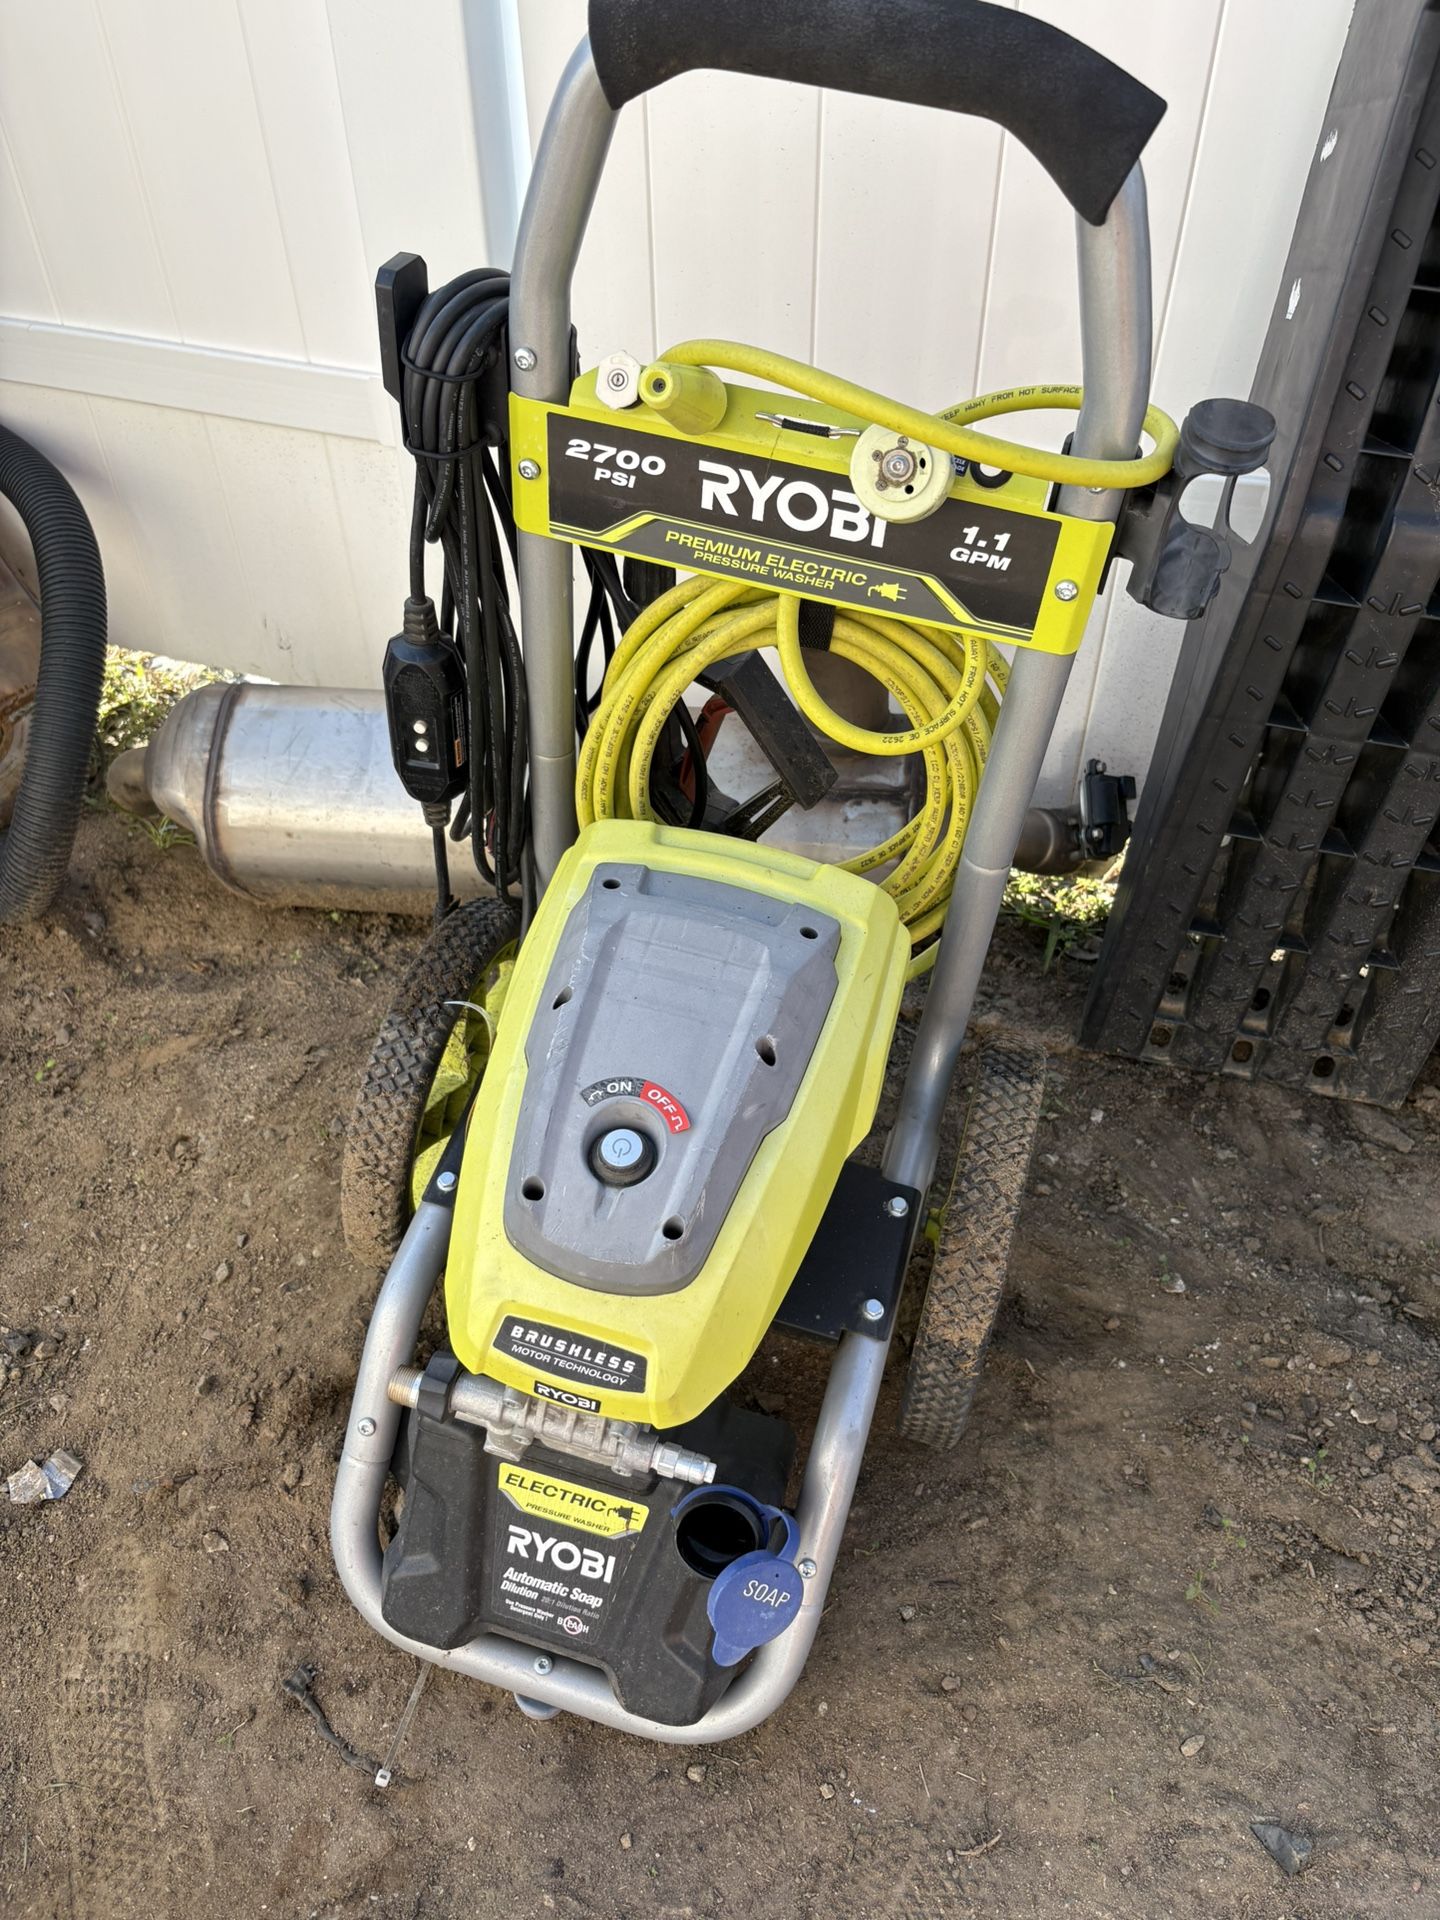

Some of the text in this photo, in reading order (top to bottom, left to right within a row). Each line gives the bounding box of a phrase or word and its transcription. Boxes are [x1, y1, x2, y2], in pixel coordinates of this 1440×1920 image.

[1018, 388, 1036, 397] HOT
[565, 438, 666, 476] 2700
[594, 467, 636, 489] PSI
[698, 459, 888, 548] RYOBI
[962, 526, 1011, 551] 1.1
[665, 530, 867, 586] PREMIUM ELECTRIC
[693, 551, 835, 590] PRESSURE WASHER
[949, 547, 1012, 571] GPM
[967, 666, 978, 688] FROM
[957, 690, 969, 707] HOT
[924, 709, 956, 735] SURFACE
[607, 1081, 677, 1113] ON OFF
[511, 1325, 636, 1373] BRUSHLESS
[511, 1344, 627, 1386] MOTOR TECHNOLOGY
[536, 1383, 597, 1411] RYOBI
[505, 1473, 607, 1512] ELECTRIC
[526, 1502, 610, 1532] PRESSURE WASHER
[507, 1524, 616, 1584] RYOBI
[500, 1580, 539, 1600] Dilution
[556, 1601, 581, 1613] Dilution
[503, 1567, 603, 1609] Automatic Soap
[743, 1580, 790, 1607] SOAP
